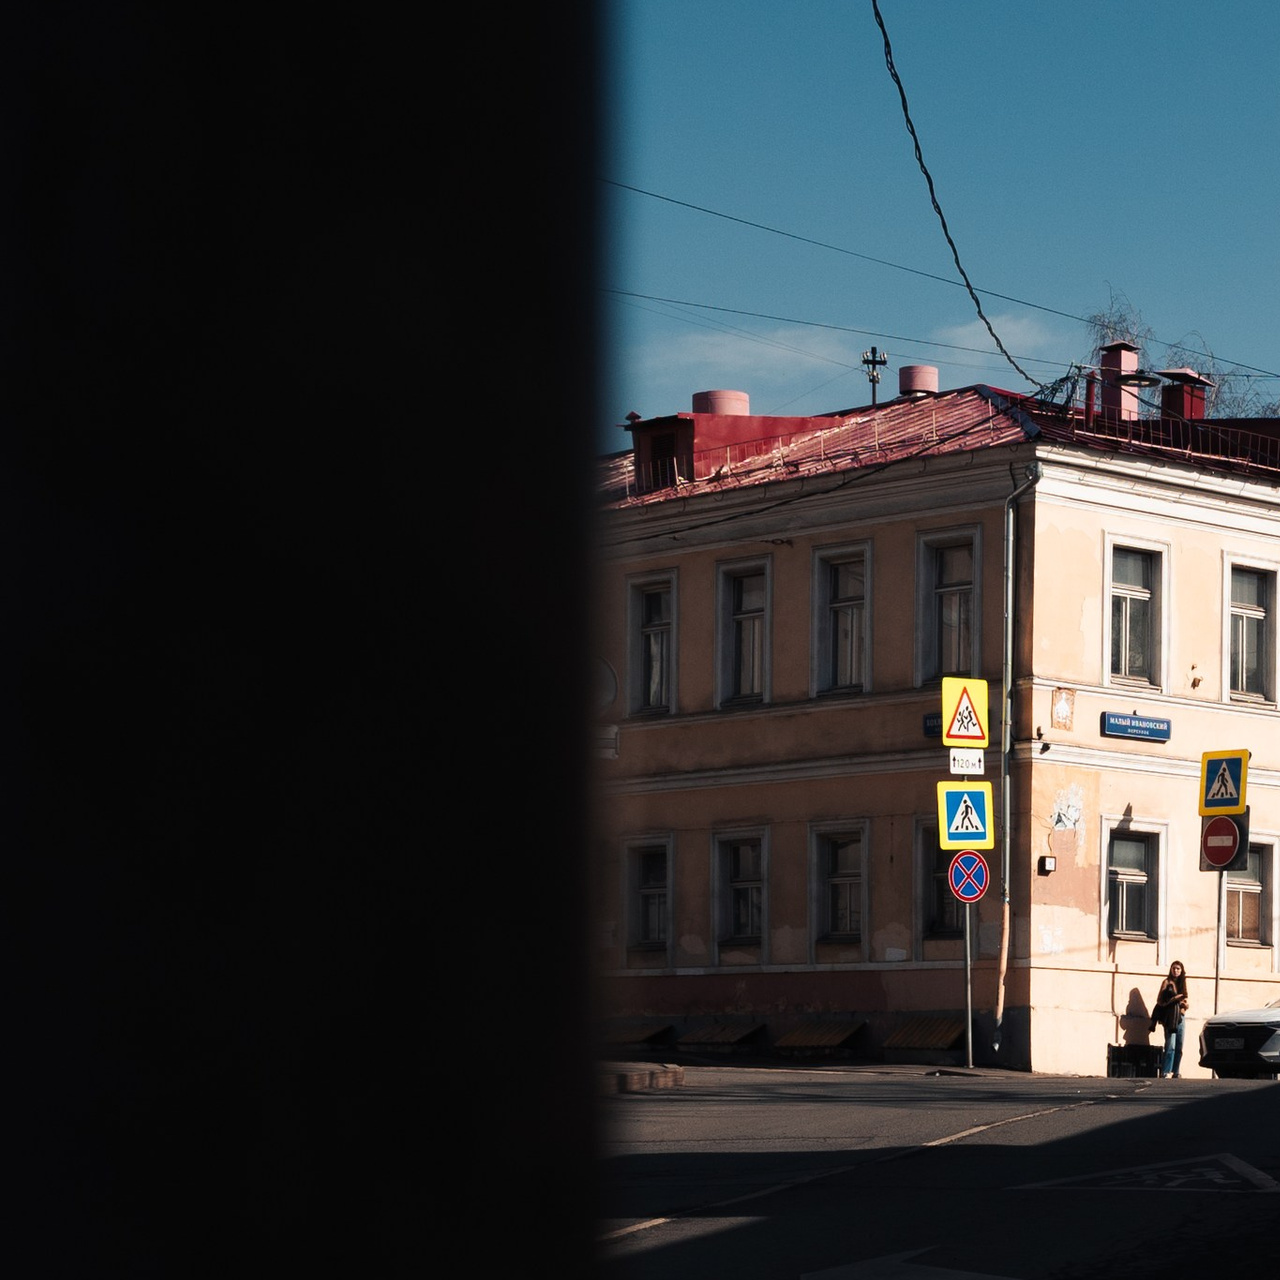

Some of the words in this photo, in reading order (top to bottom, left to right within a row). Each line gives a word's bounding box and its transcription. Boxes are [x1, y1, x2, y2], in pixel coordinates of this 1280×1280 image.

[1109, 716, 1131, 726] МАЛЫЙ
[1131, 719, 1168, 731] ИВАНОВСКИЙ
[956, 758, 970, 769] 120
